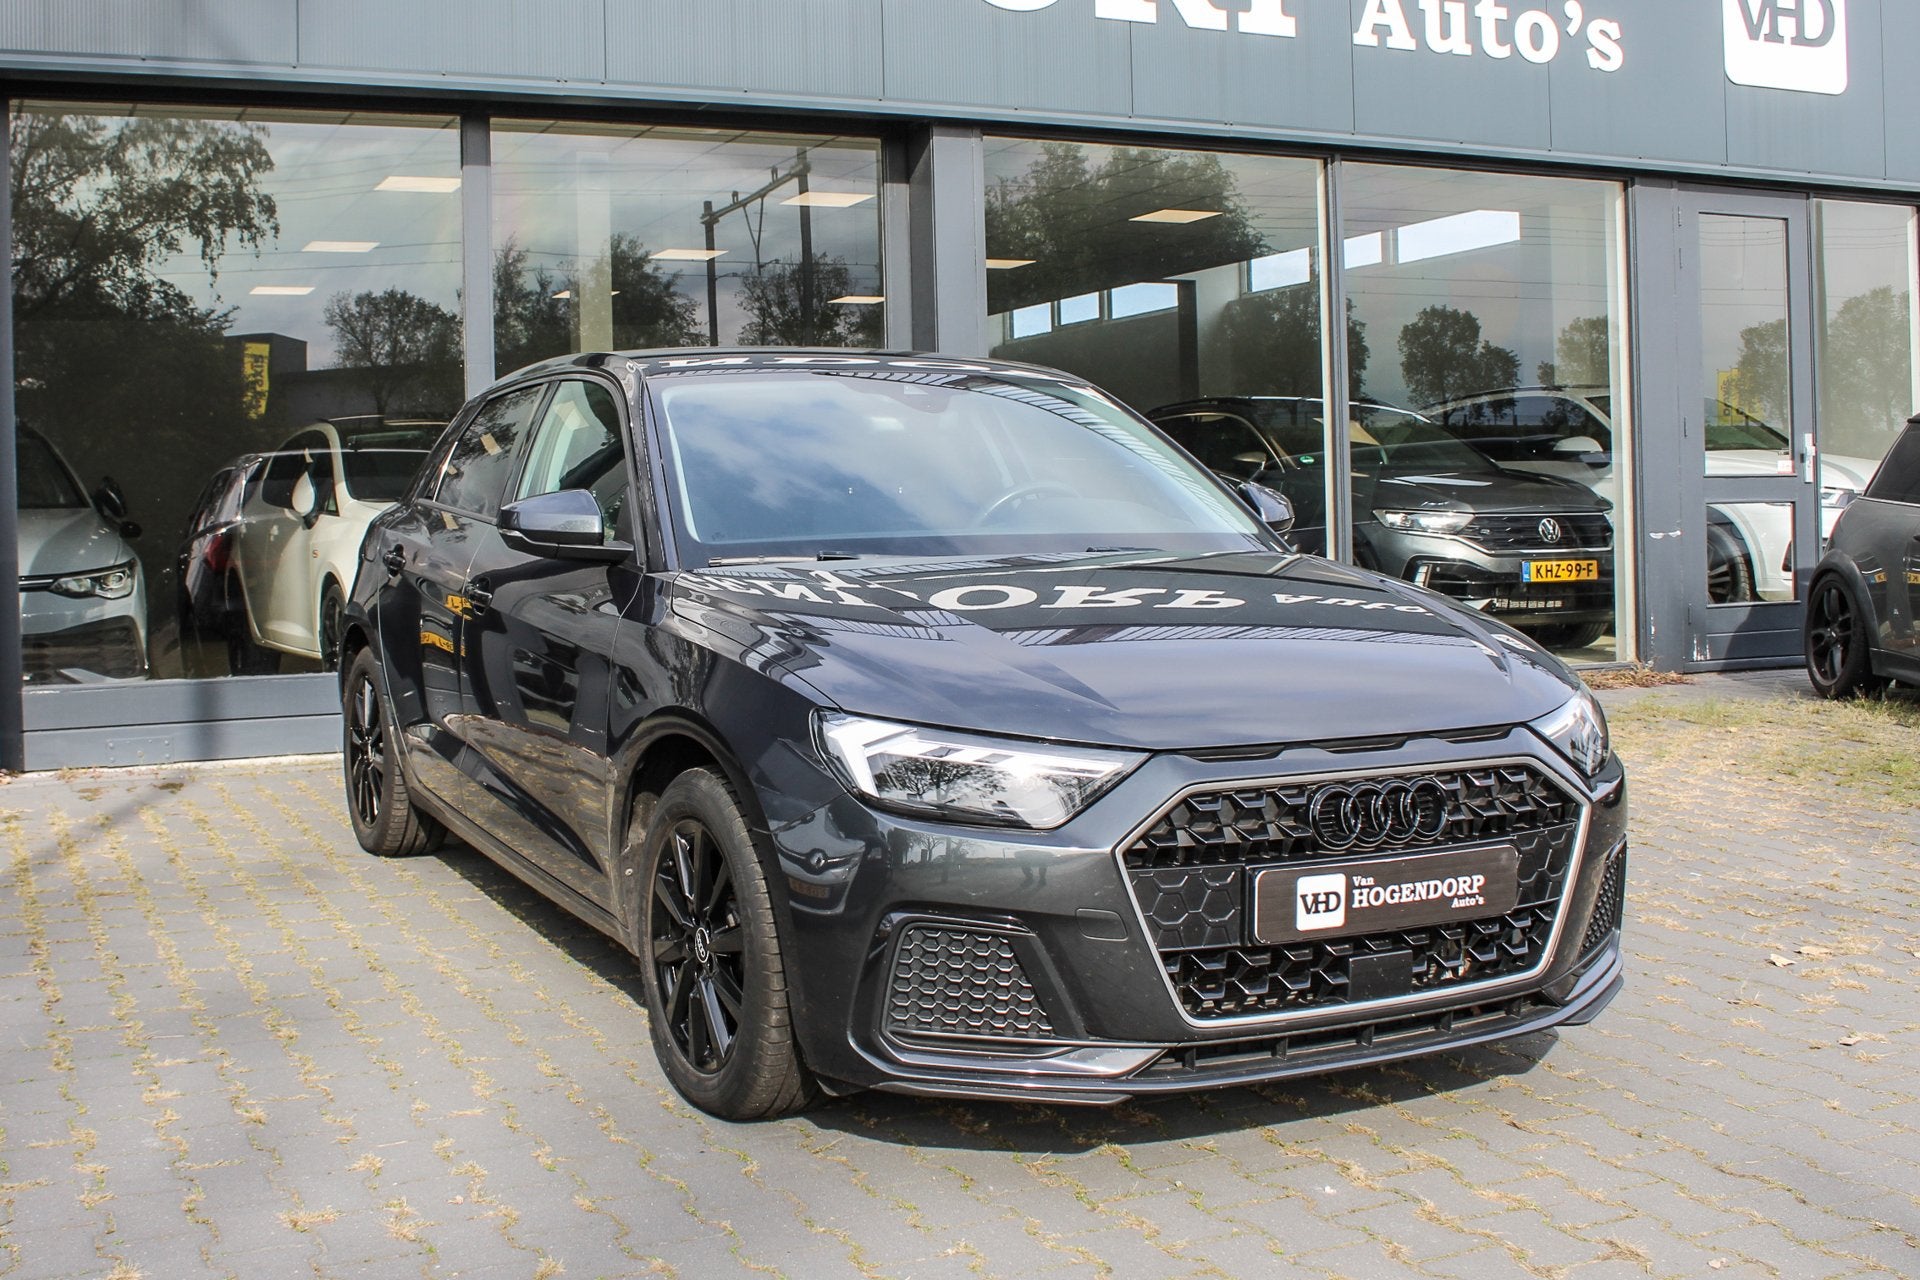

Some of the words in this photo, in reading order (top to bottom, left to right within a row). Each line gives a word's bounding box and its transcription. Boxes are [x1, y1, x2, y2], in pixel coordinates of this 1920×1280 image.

[1353, 0, 1624, 72] Auto's
[1535, 562, 1594, 579] KHZ-99-F
[1352, 875, 1374, 887] Van
[1352, 874, 1485, 908] HOGENDORP
[1300, 891, 1342, 915] VHD
[1451, 896, 1485, 909] Auto's
